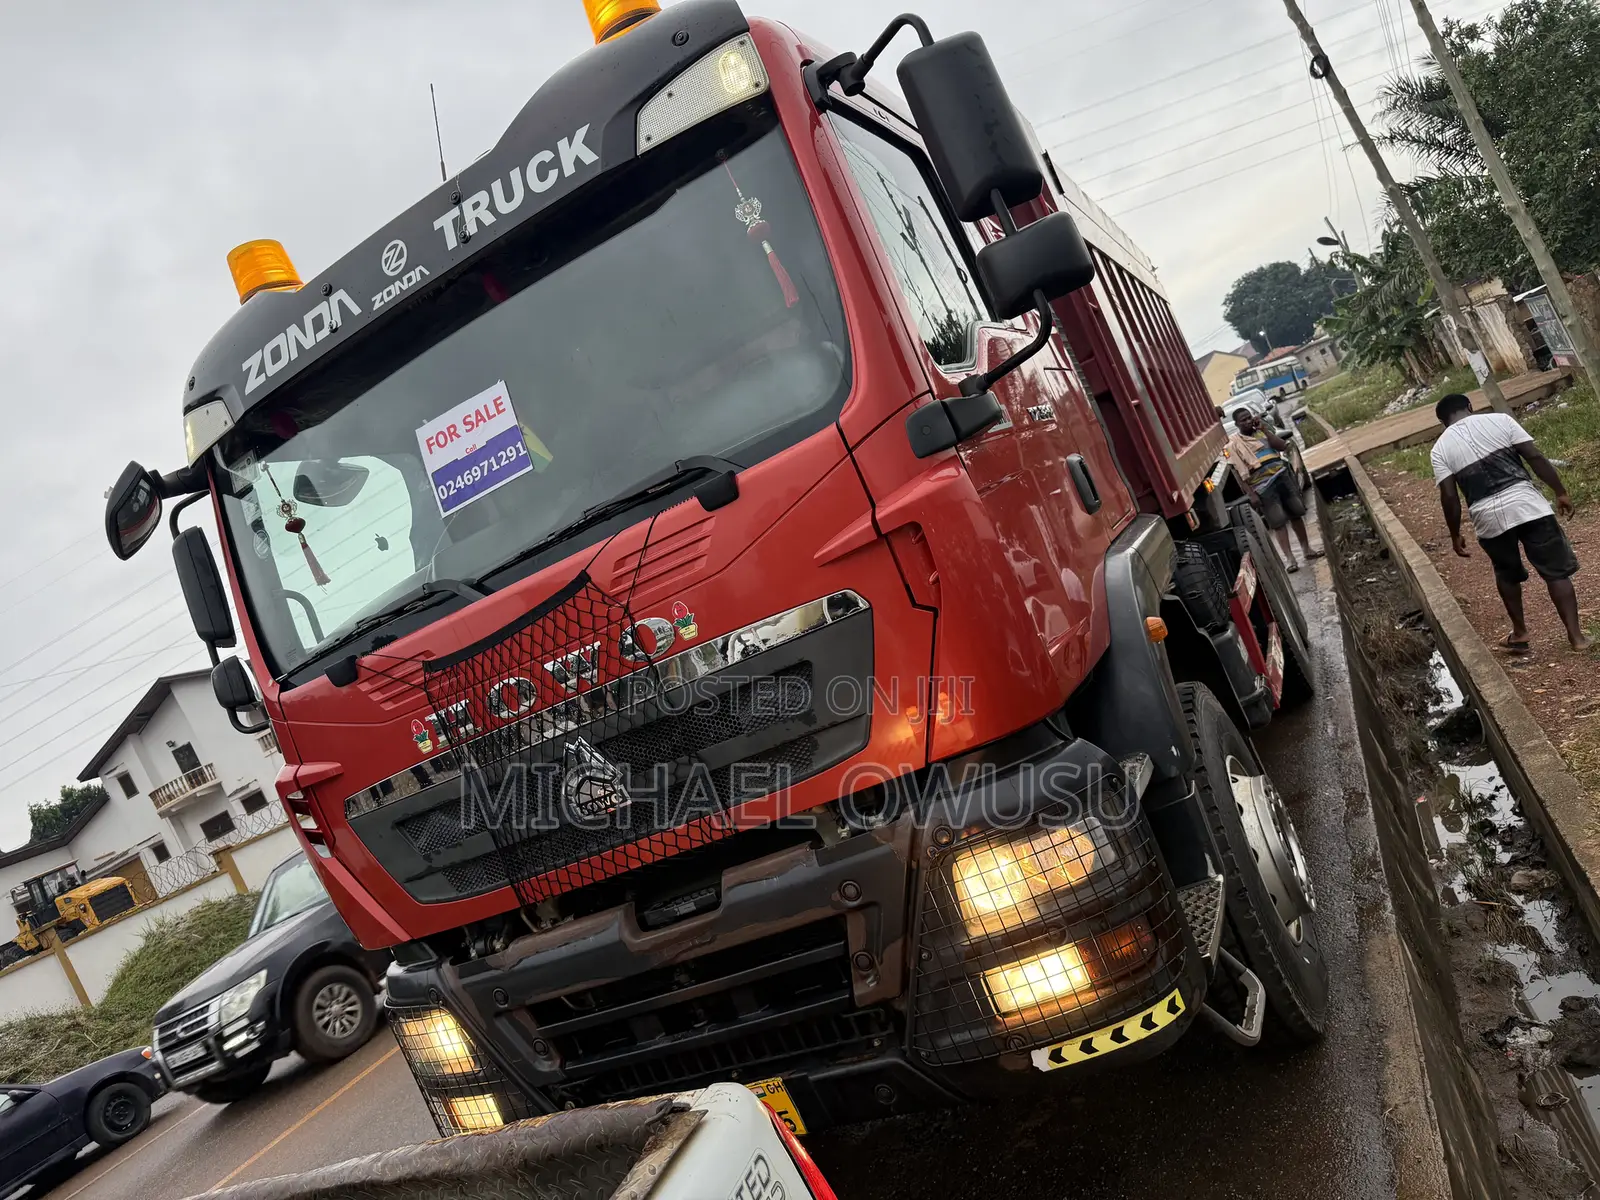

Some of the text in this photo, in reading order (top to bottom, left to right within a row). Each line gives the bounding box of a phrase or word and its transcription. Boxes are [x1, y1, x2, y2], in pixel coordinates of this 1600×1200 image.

[241, 123, 600, 395] ZONDA TRUCK
[371, 264, 431, 311] ZONDA
[425, 395, 506, 455] FOR SALE
[465, 443, 477, 455] Call
[437, 440, 527, 500] 0246971291
[766, 1081, 785, 1095] GH
